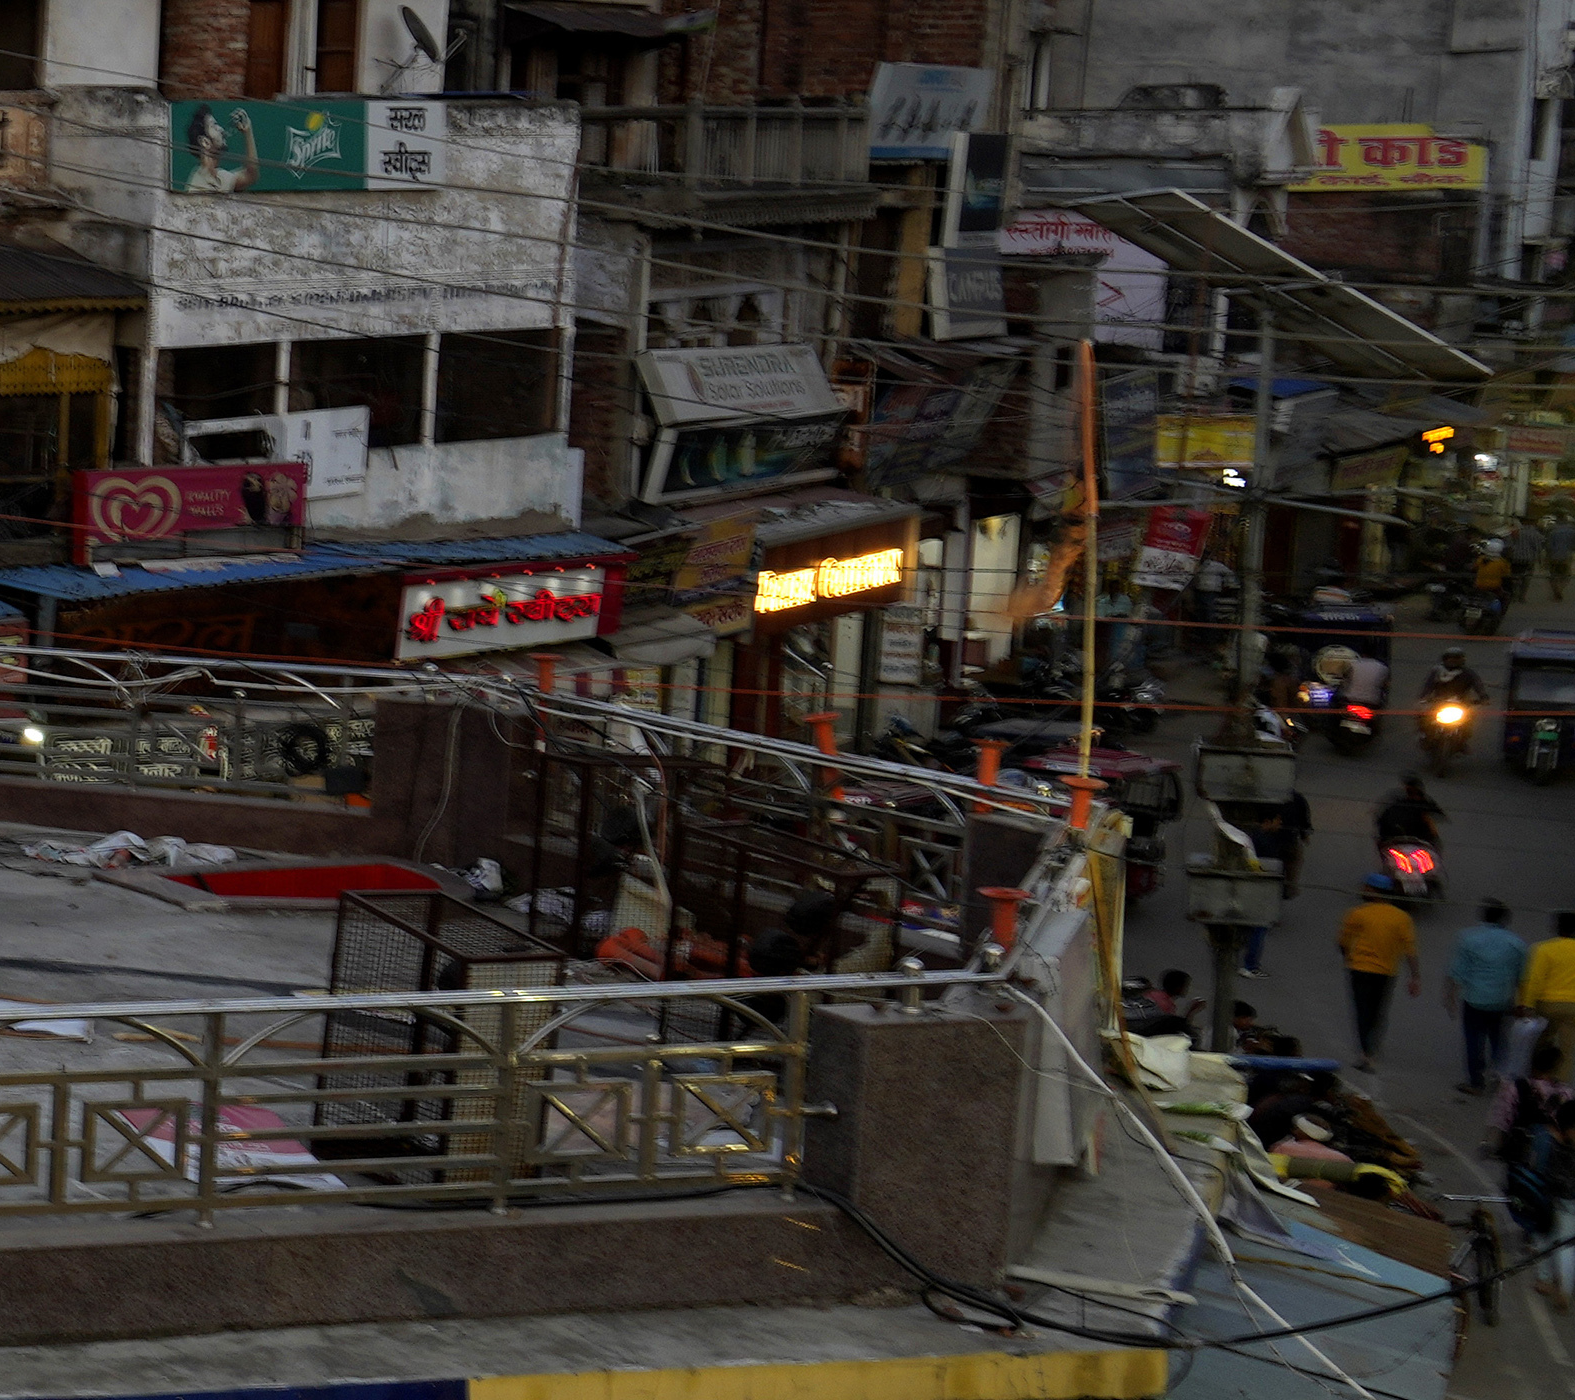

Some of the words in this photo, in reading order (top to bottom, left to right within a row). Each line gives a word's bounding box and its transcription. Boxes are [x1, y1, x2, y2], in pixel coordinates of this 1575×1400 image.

[290, 125, 337, 169] Sprite
[698, 352, 797, 378] SURENDRA
[747, 378, 806, 398] Solutions
